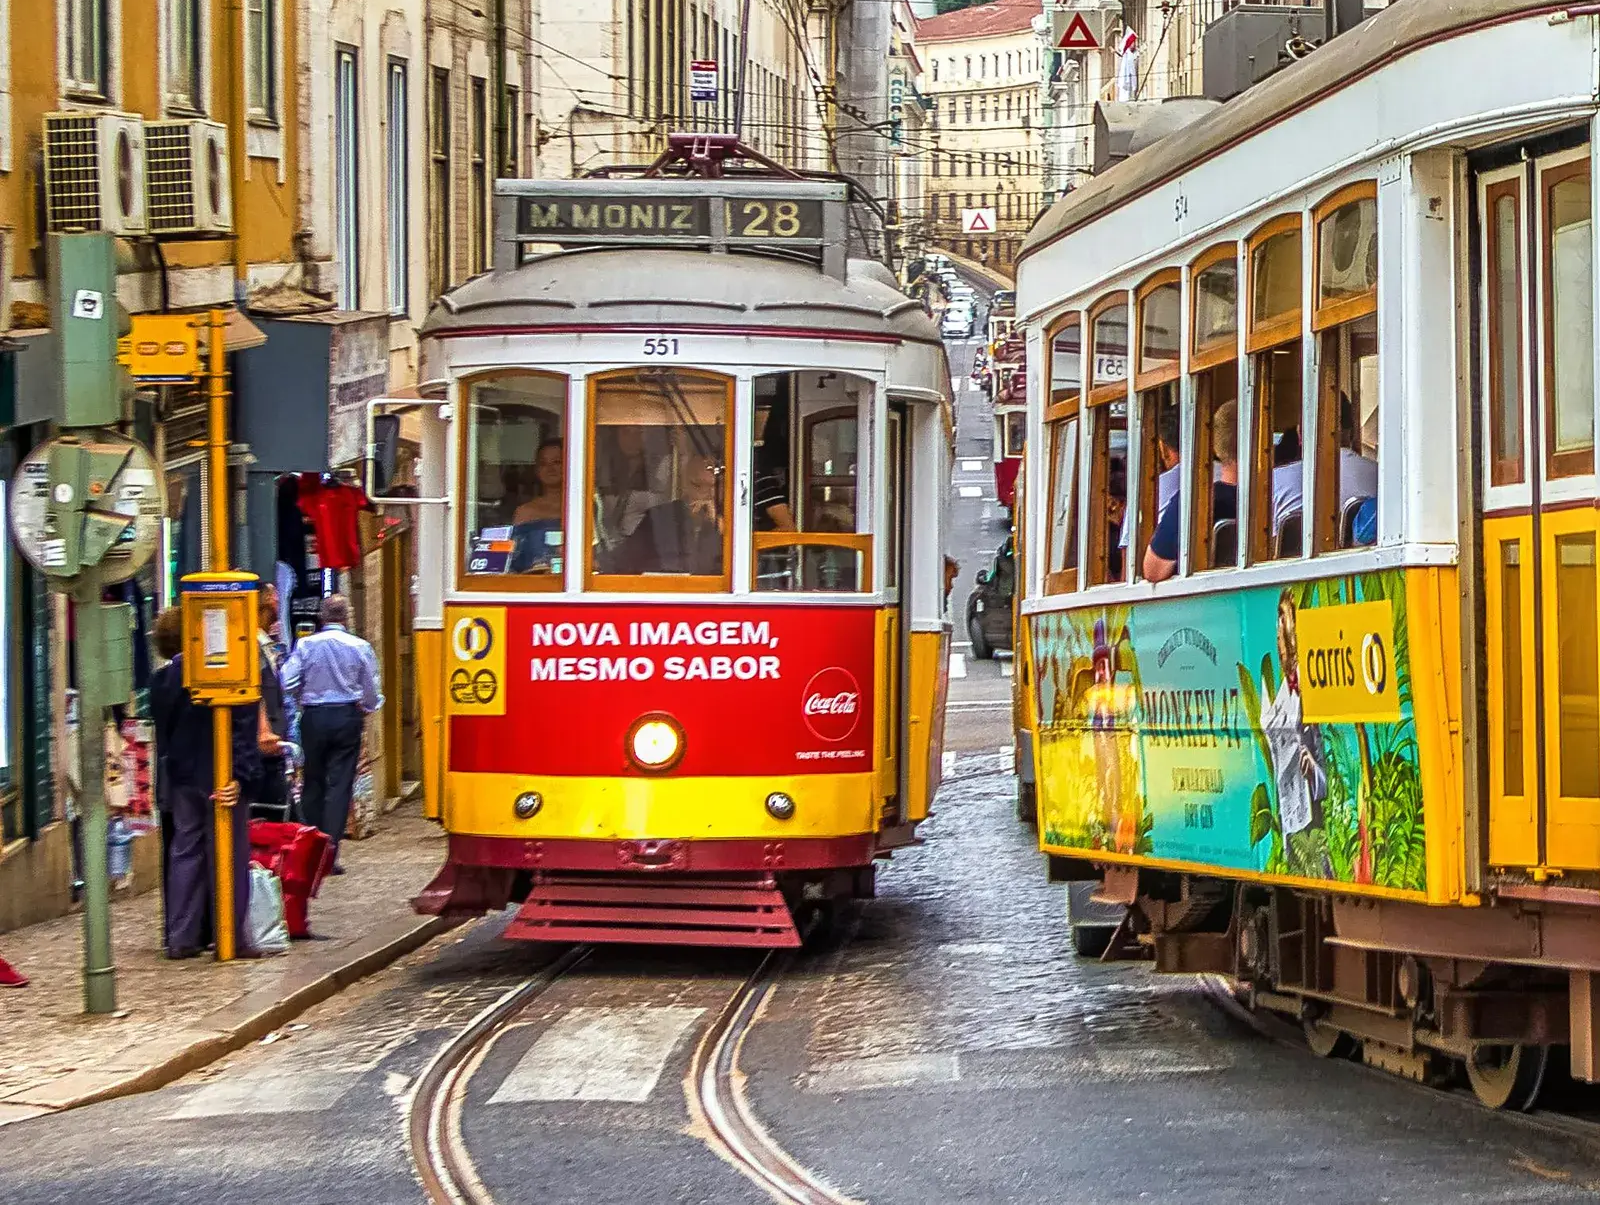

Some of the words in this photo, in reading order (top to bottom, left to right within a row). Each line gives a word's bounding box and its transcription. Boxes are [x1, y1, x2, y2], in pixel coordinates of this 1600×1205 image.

[571, 204, 693, 229] MONIZ
[742, 201, 801, 237] 28
[643, 338, 679, 356] 551
[531, 621, 621, 647] NOVA
[629, 620, 780, 650] IMAGEM,
[530, 656, 655, 682] MESMO
[663, 655, 781, 680] SABOR
[1307, 628, 1355, 689] carris
[1144, 689, 1218, 748] MONKEY
[1220, 686, 1241, 750] 47
